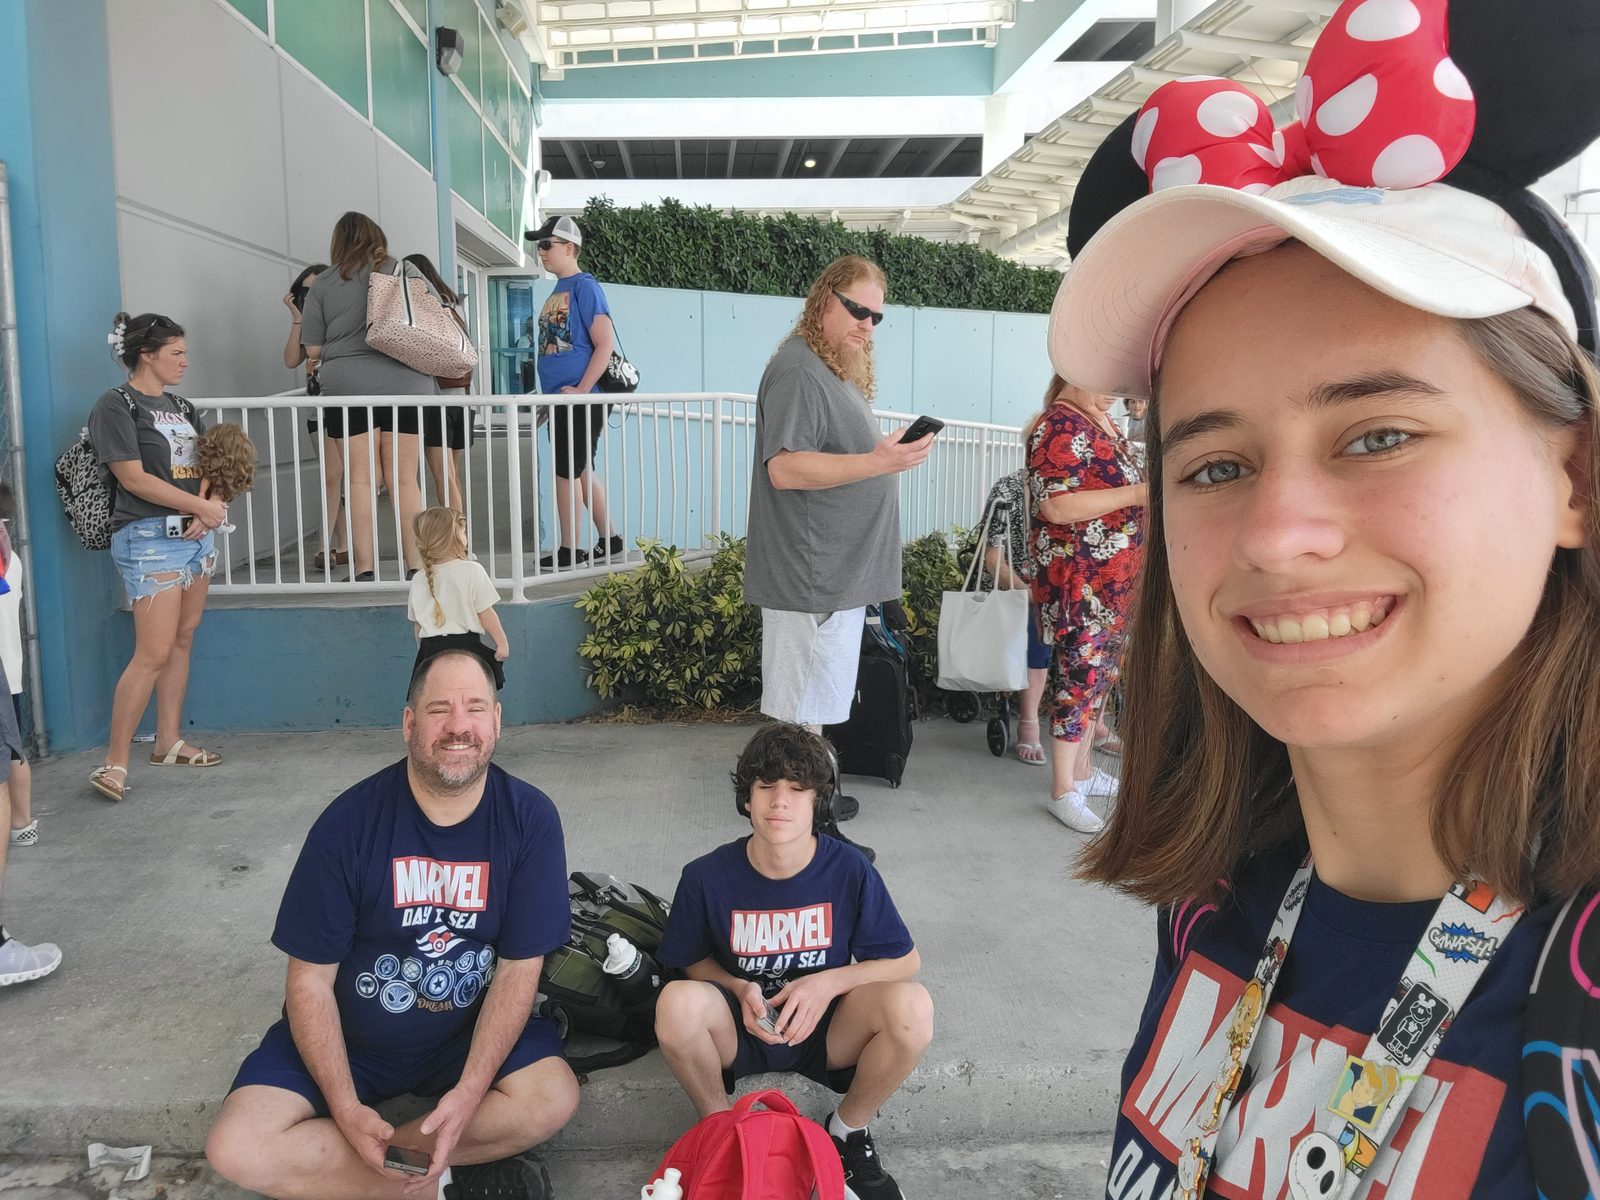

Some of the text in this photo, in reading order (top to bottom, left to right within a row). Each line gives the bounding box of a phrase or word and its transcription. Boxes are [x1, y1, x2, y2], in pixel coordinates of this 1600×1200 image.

[402, 906, 432, 926] DAY
[449, 912, 477, 930] SEA
[733, 907, 830, 953] MARVEL
[772, 954, 794, 969] AT
[798, 950, 826, 969] SEA
